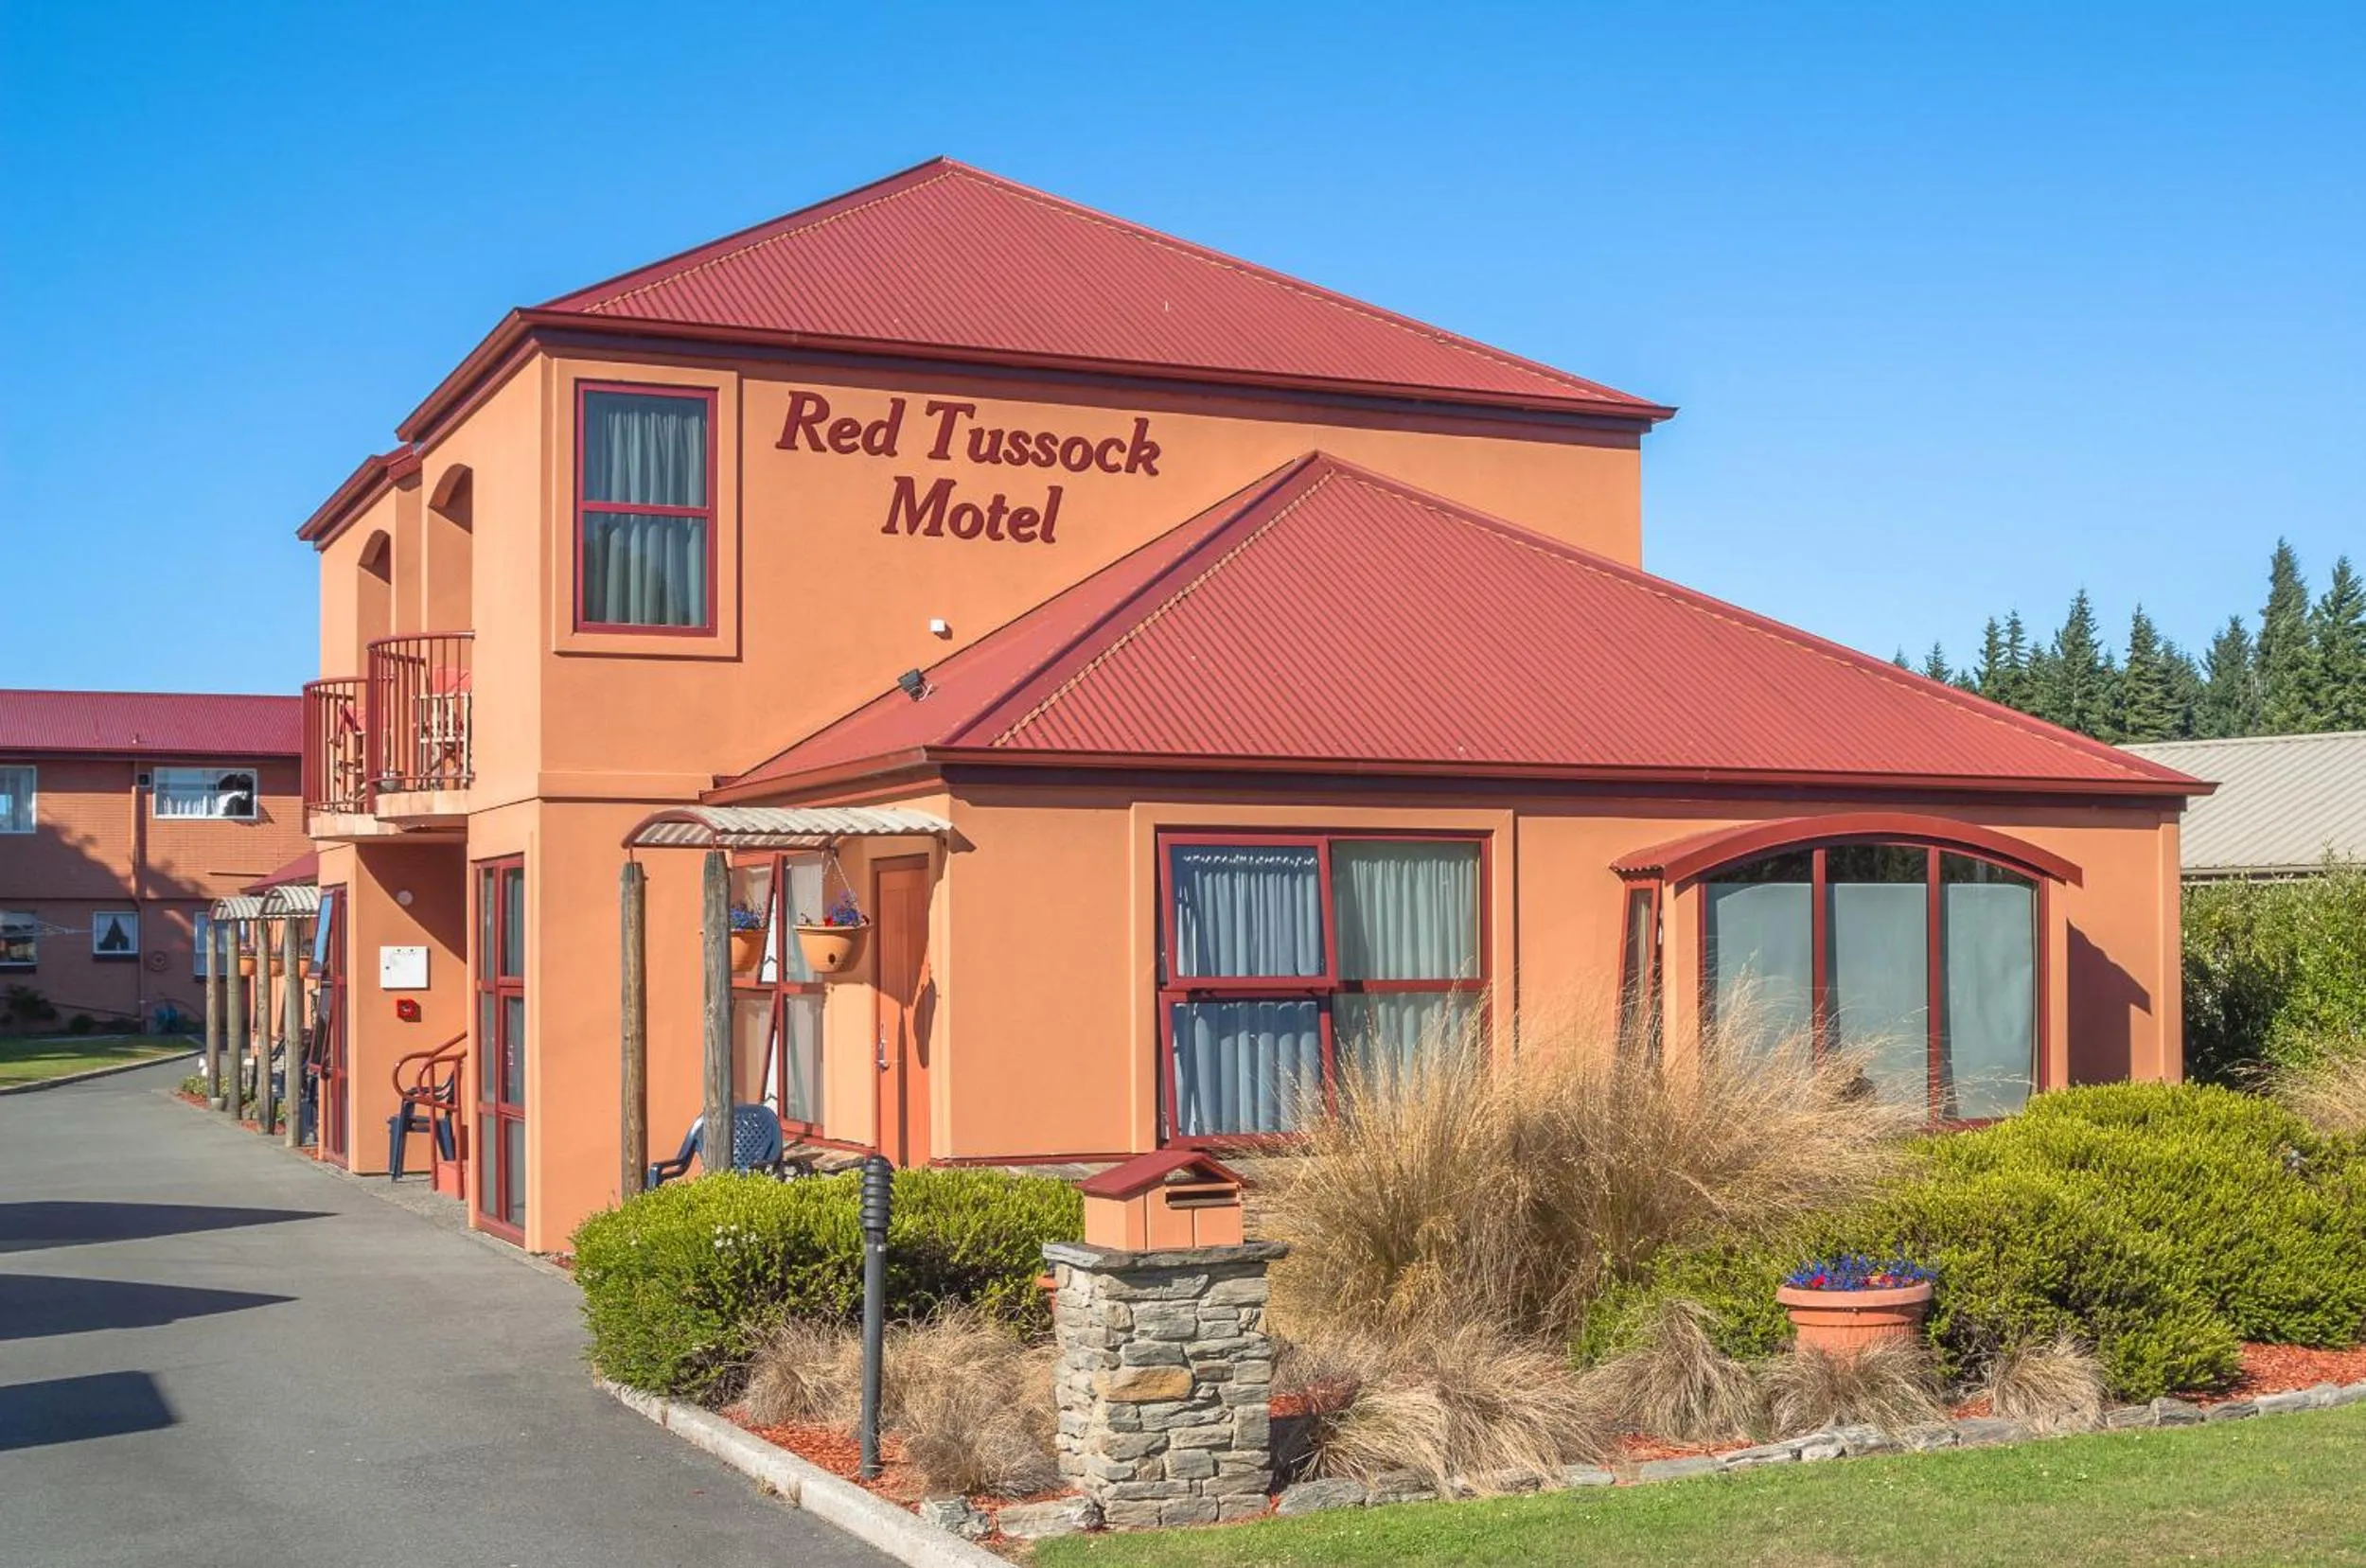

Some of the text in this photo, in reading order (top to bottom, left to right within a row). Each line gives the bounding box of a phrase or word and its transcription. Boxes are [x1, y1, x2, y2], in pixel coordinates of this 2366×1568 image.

[775, 390, 1160, 476] Red Tussock
[881, 476, 1064, 543] Motel
